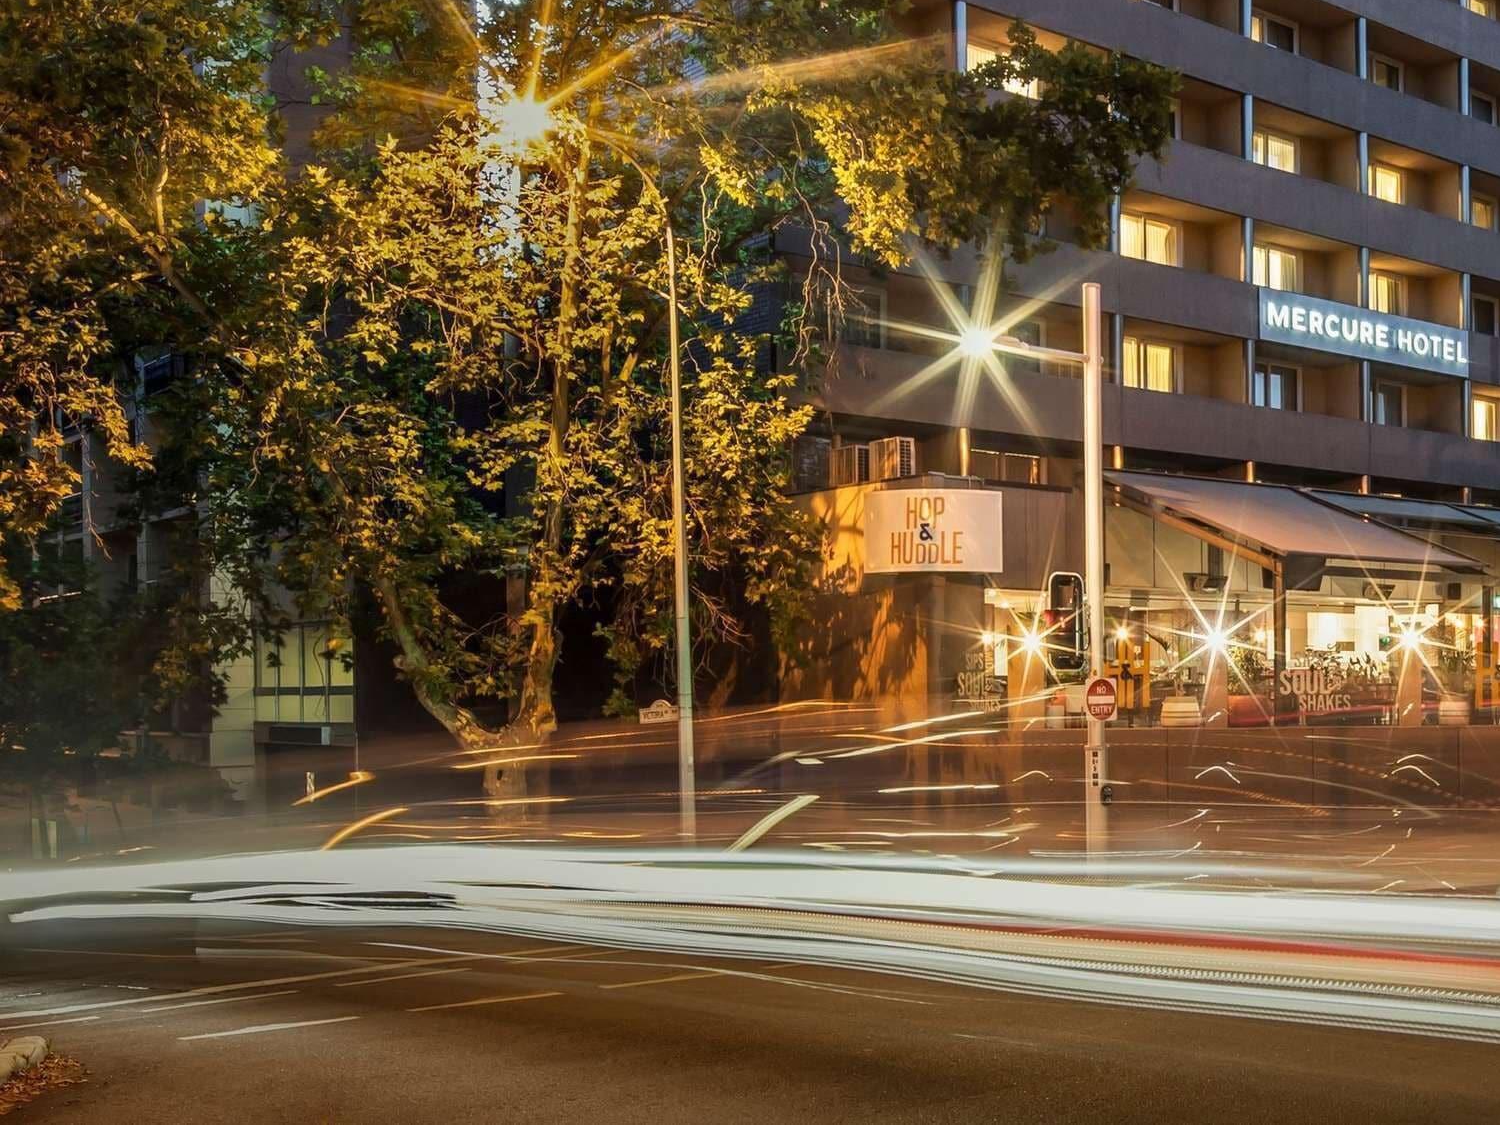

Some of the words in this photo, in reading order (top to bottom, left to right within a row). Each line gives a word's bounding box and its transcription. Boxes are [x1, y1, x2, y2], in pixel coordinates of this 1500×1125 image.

[1266, 301, 1389, 348] MERCURE
[1396, 328, 1468, 364] HOTEL
[906, 496, 945, 530] HOP
[919, 522, 933, 542] &
[890, 530, 963, 565] HUDDLE
[1096, 685, 1107, 695] NO
[1279, 670, 1332, 695] SOUL
[1090, 704, 1113, 715] ENTRY
[1299, 694, 1351, 713] SHAKES
